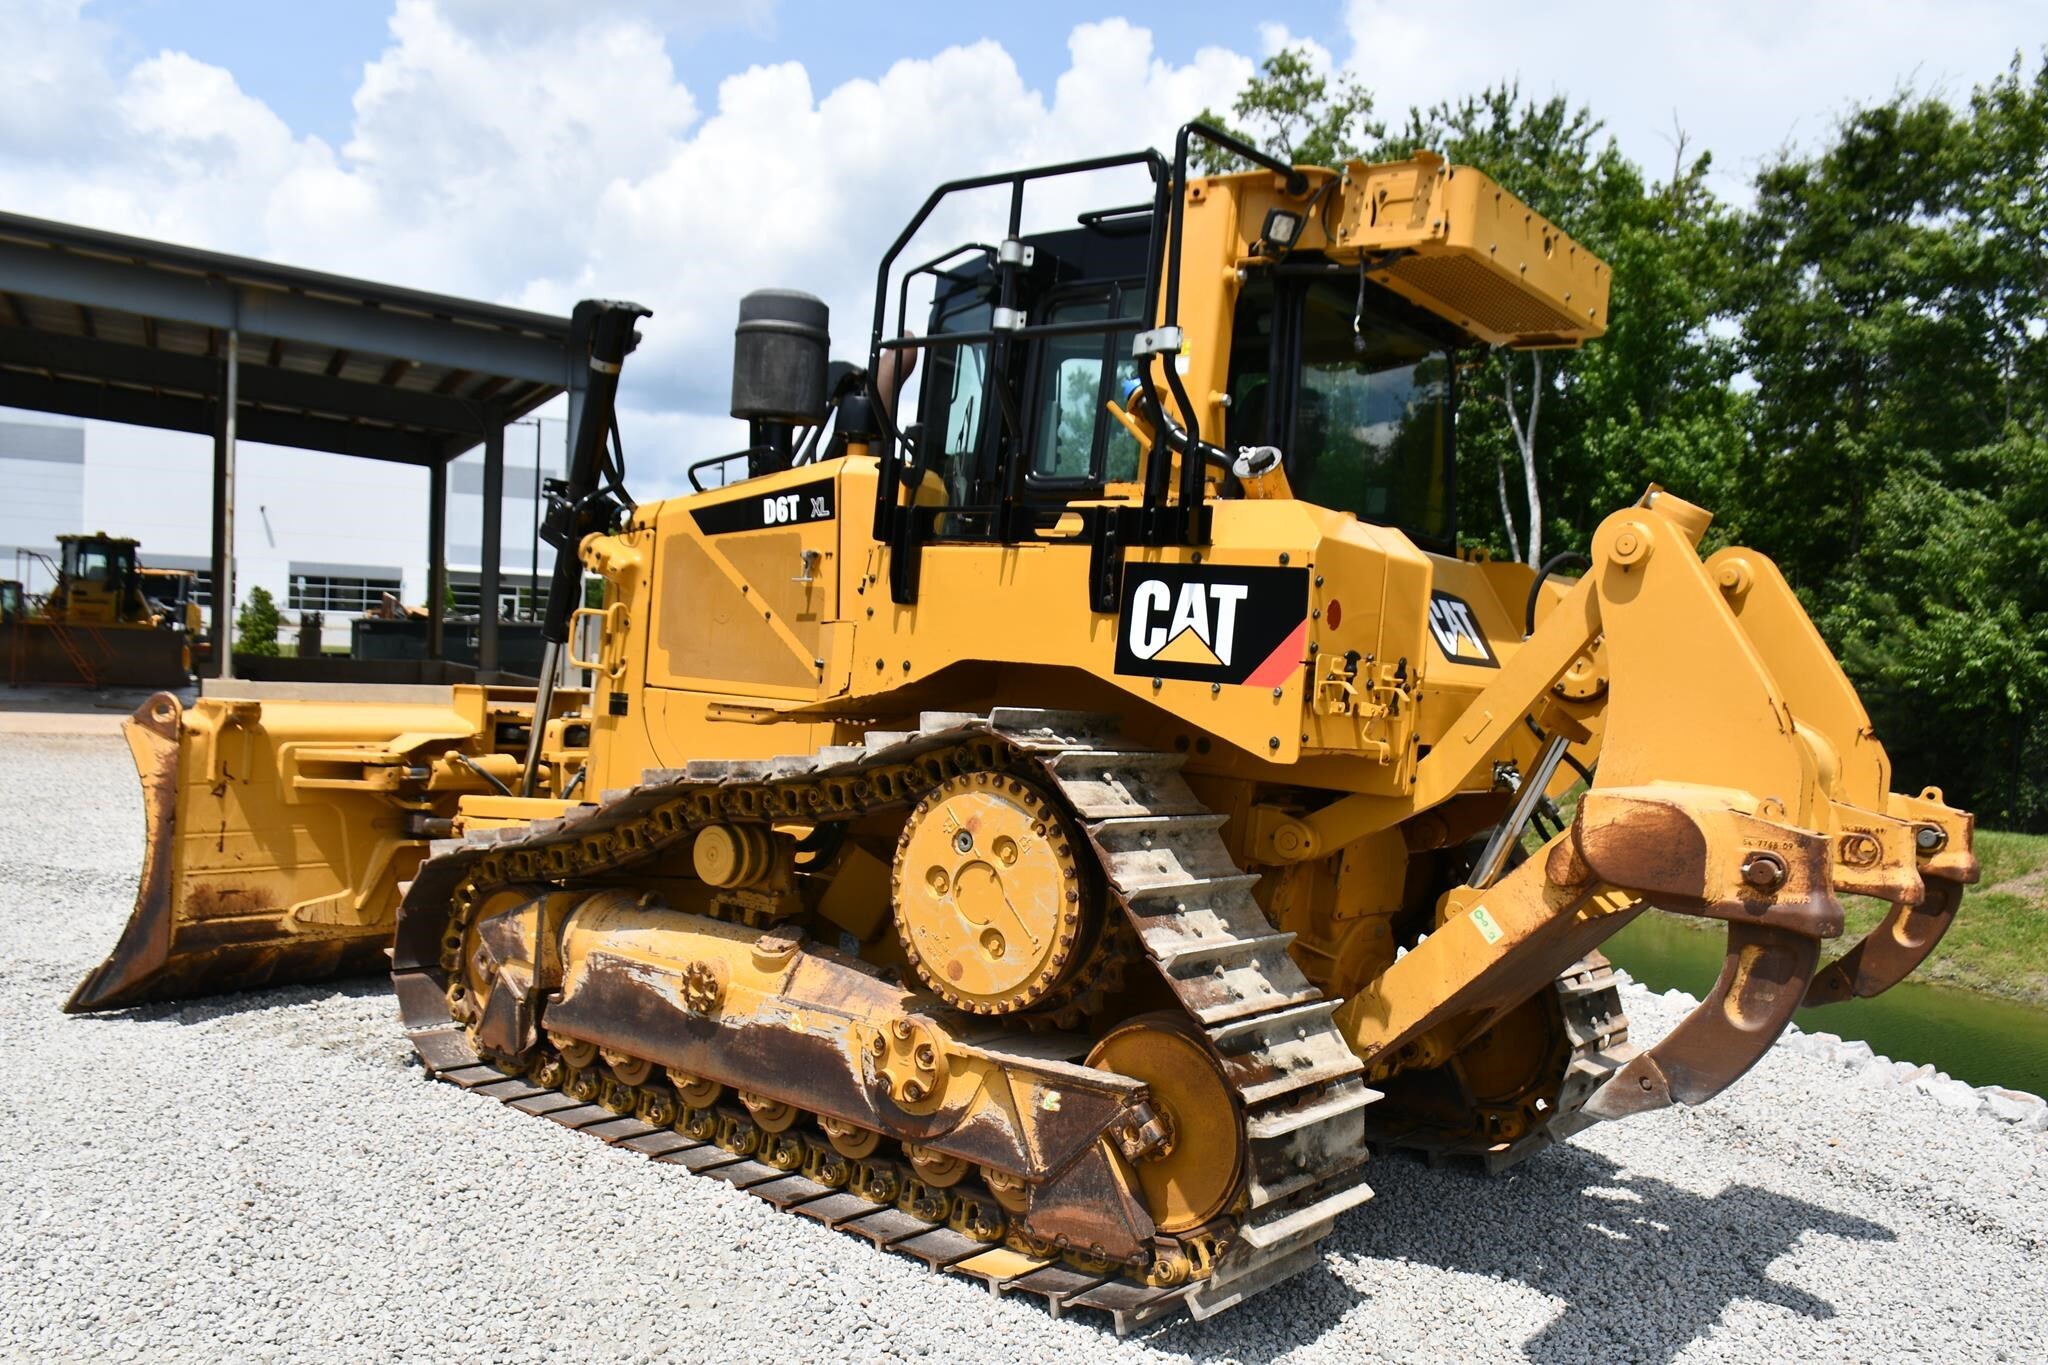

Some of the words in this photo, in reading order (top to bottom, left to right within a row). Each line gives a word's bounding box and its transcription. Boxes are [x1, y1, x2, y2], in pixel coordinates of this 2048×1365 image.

[763, 494, 800, 525] D6T
[810, 496, 830, 518] XL
[1129, 580, 1248, 667] CAT
[1429, 599, 1490, 660] CAT
